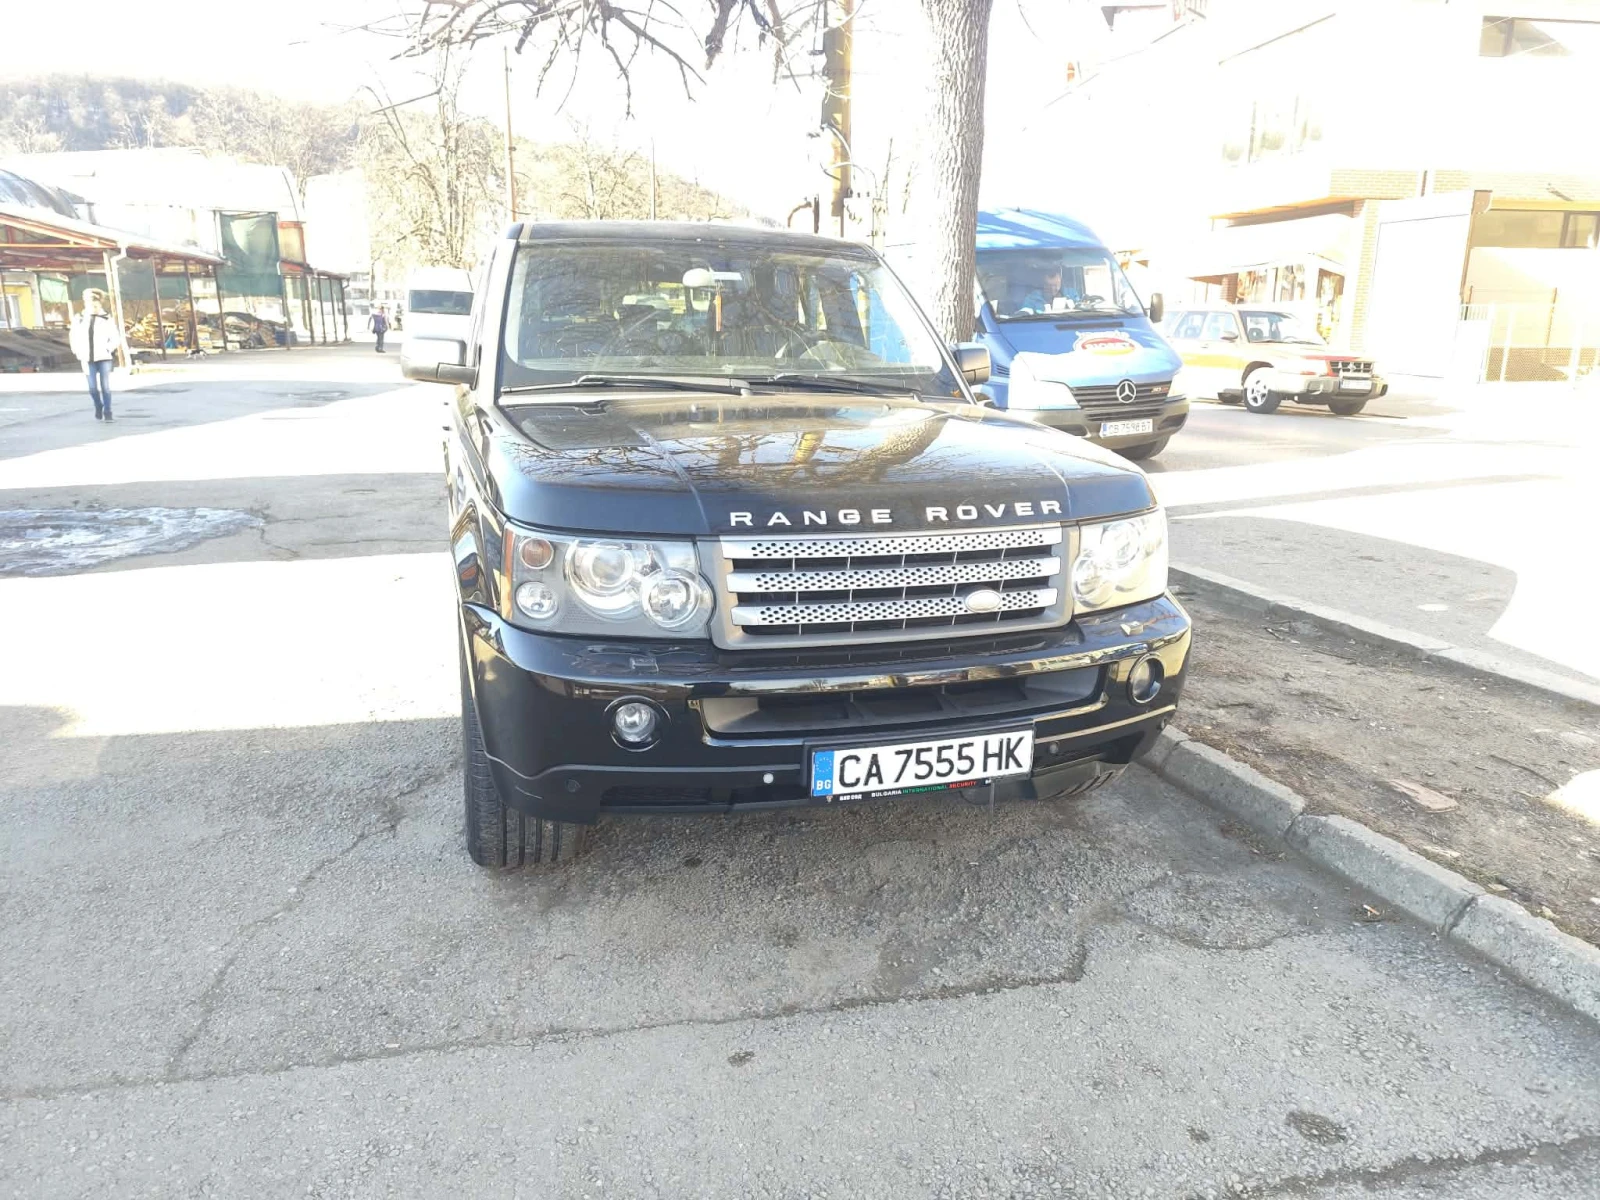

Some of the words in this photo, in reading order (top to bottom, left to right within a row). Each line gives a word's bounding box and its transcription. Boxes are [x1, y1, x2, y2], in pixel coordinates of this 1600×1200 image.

[730, 508, 892, 526] RANGE
[926, 500, 1062, 521] ROVER
[838, 753, 884, 788] CA
[893, 742, 975, 784] 7555
[982, 736, 1025, 773] HK
[815, 779, 832, 791] BG
[871, 789, 902, 798] BULGARIA
[902, 784, 949, 795] INTERNATIONAL
[949, 780, 978, 789] SECURITY
